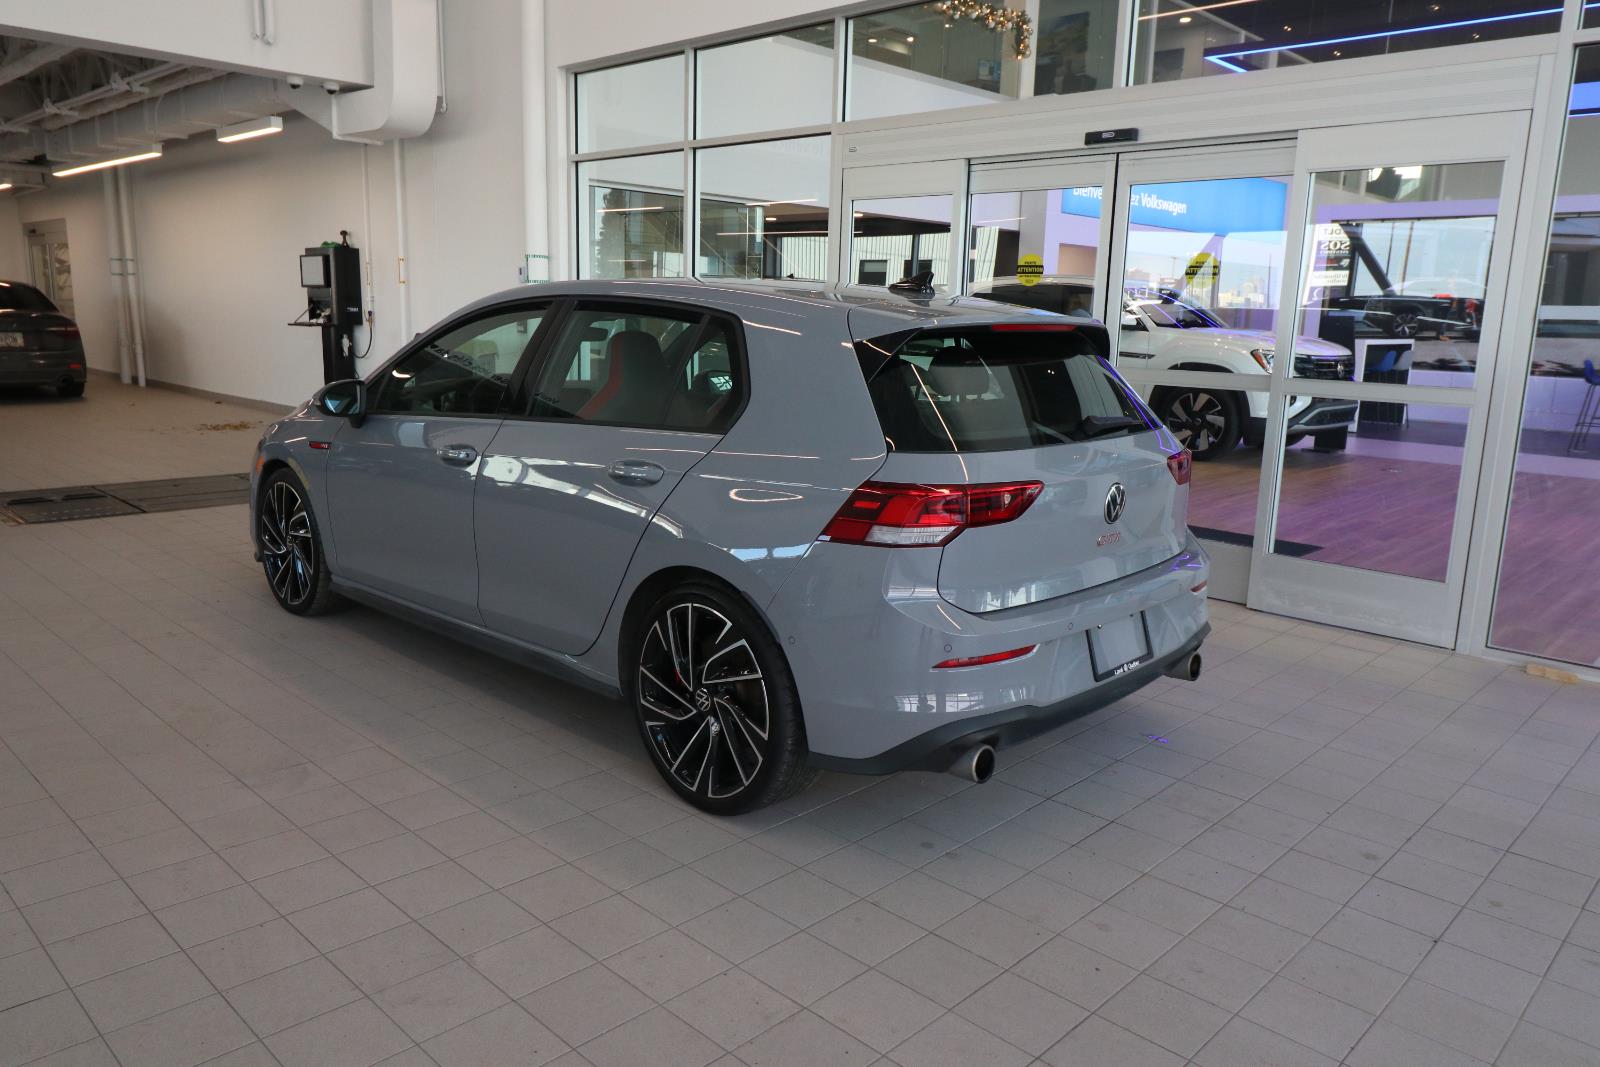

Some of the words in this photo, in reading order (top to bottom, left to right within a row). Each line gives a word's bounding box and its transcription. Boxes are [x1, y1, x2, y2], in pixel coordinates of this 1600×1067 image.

[1072, 187, 1102, 200] Bienve
[1141, 192, 1187, 216] Volkswagen
[1018, 265, 1043, 273] ATTENTION
